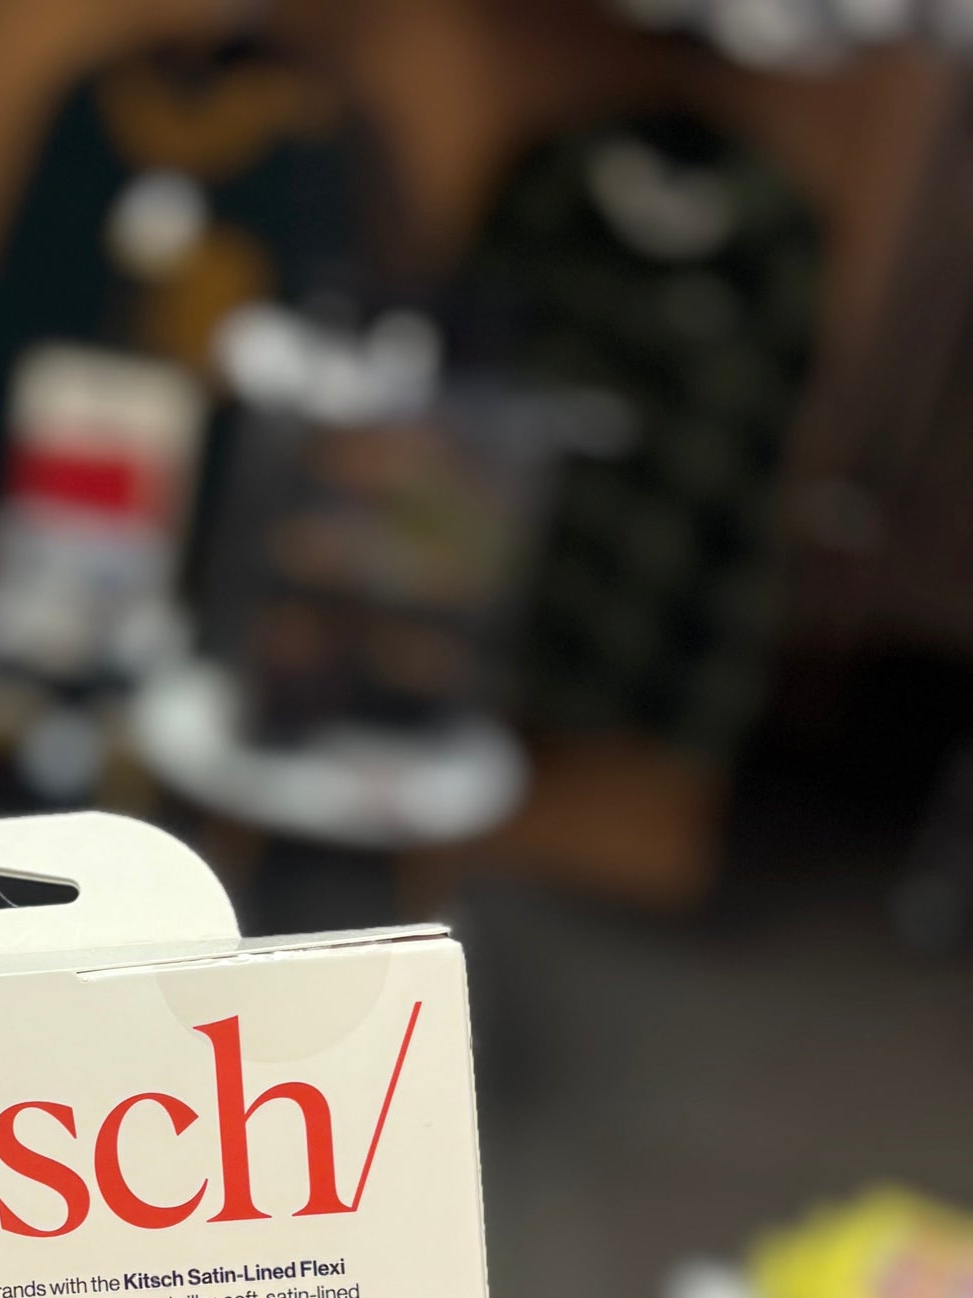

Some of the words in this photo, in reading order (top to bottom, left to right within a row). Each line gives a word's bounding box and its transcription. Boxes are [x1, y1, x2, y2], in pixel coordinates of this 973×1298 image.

[48, 1276, 89, 1296] with
[89, 1274, 121, 1294] the
[123, 1269, 185, 1291] Kitsch
[186, 1260, 298, 1287] Satin-Lined
[299, 1257, 346, 1279] Flexi
